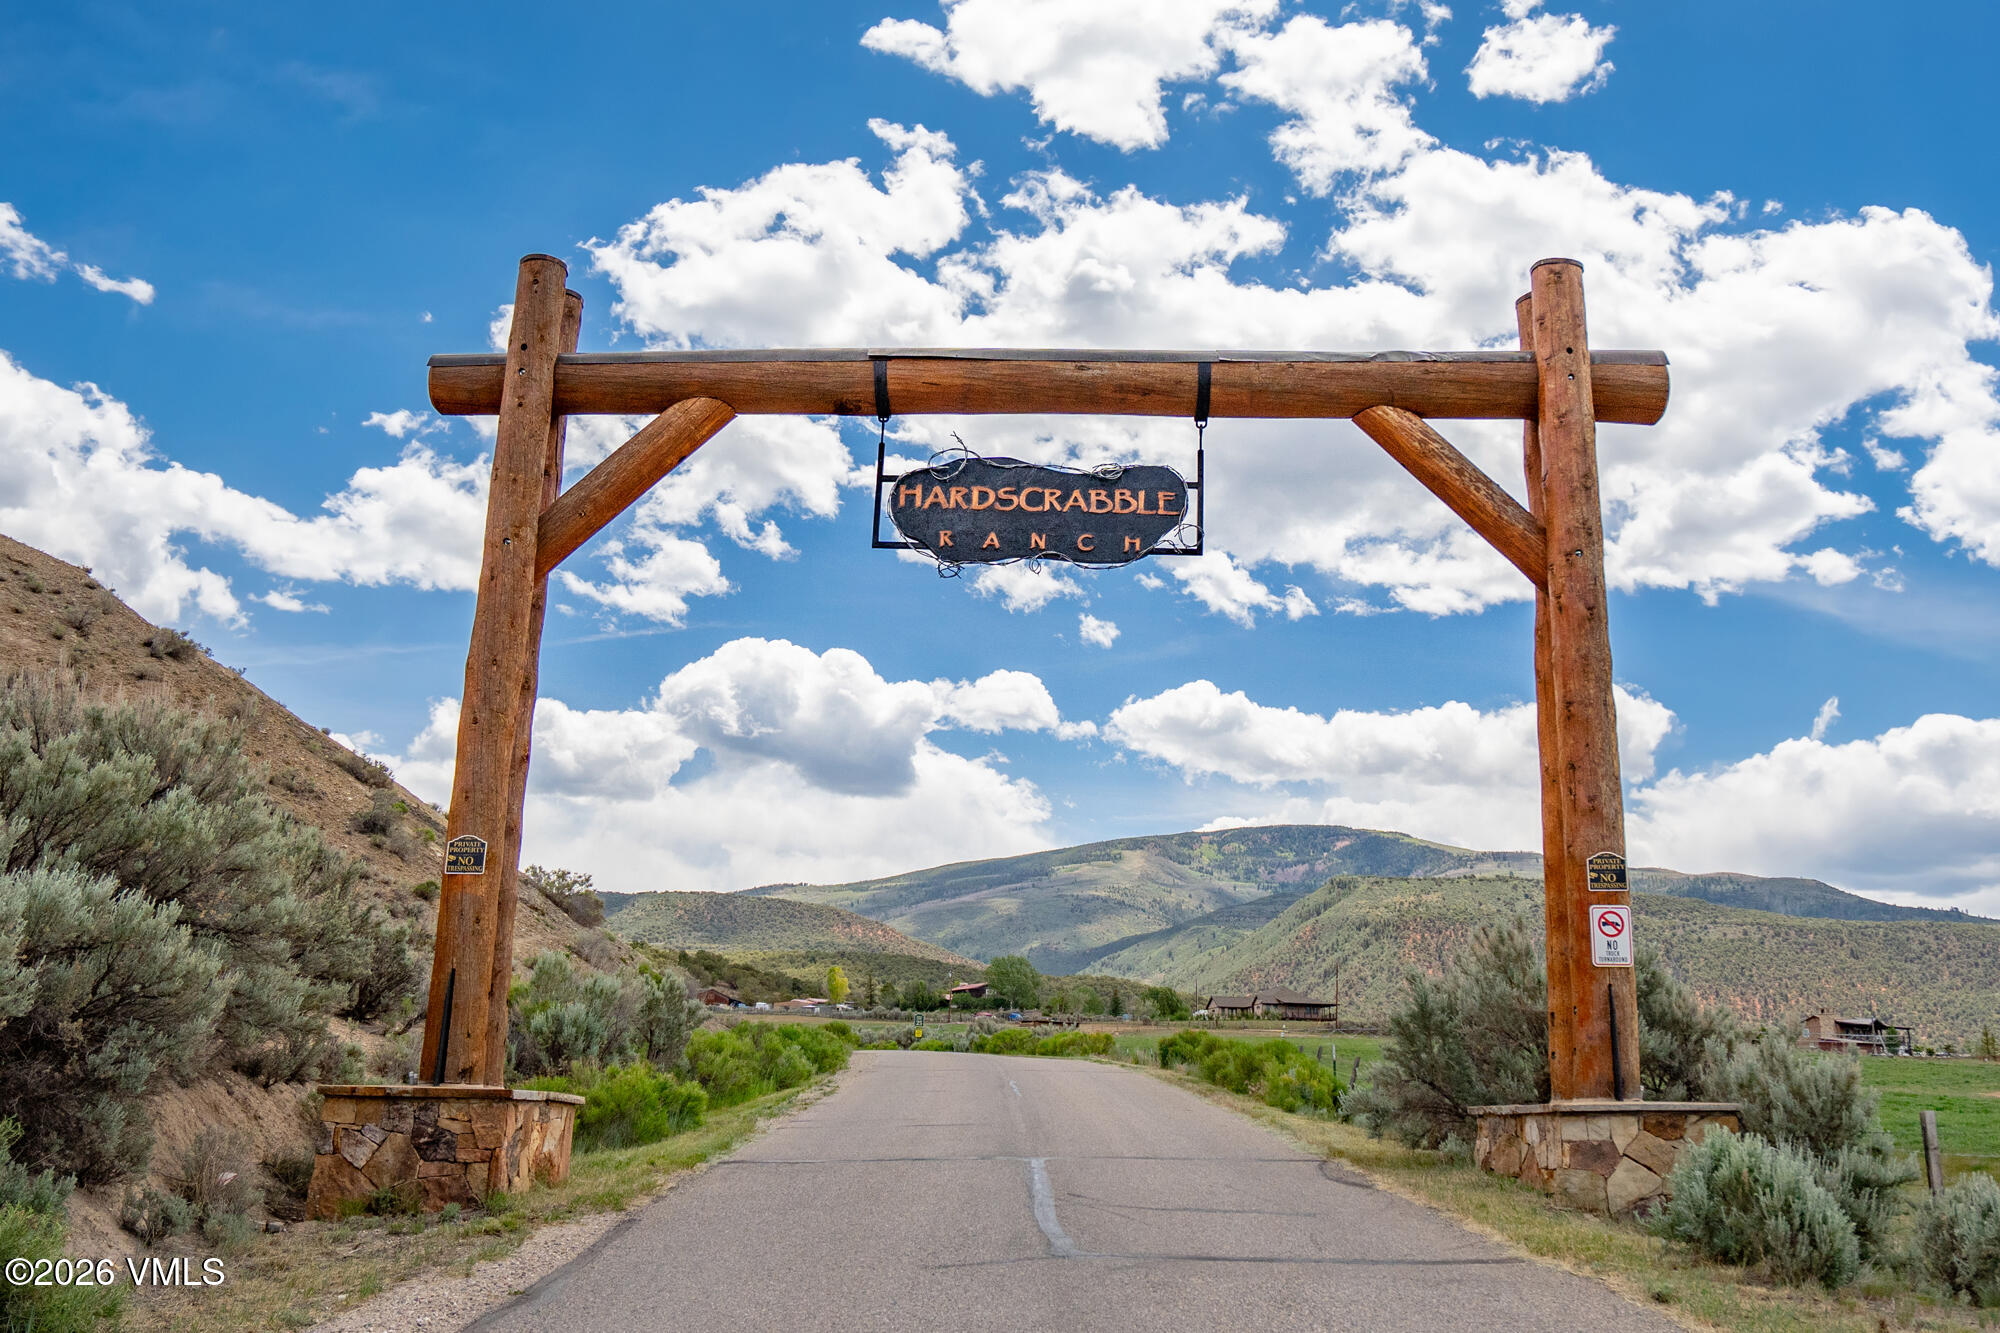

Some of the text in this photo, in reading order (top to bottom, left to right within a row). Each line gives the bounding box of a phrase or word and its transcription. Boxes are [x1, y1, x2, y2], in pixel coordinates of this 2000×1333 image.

[898, 484, 1181, 515] HARDSCRABBLE
[939, 530, 1141, 552] RANCH
[457, 856, 474, 865] NO
[1600, 874, 1616, 882] NO
[1606, 940, 1618, 950] NO
